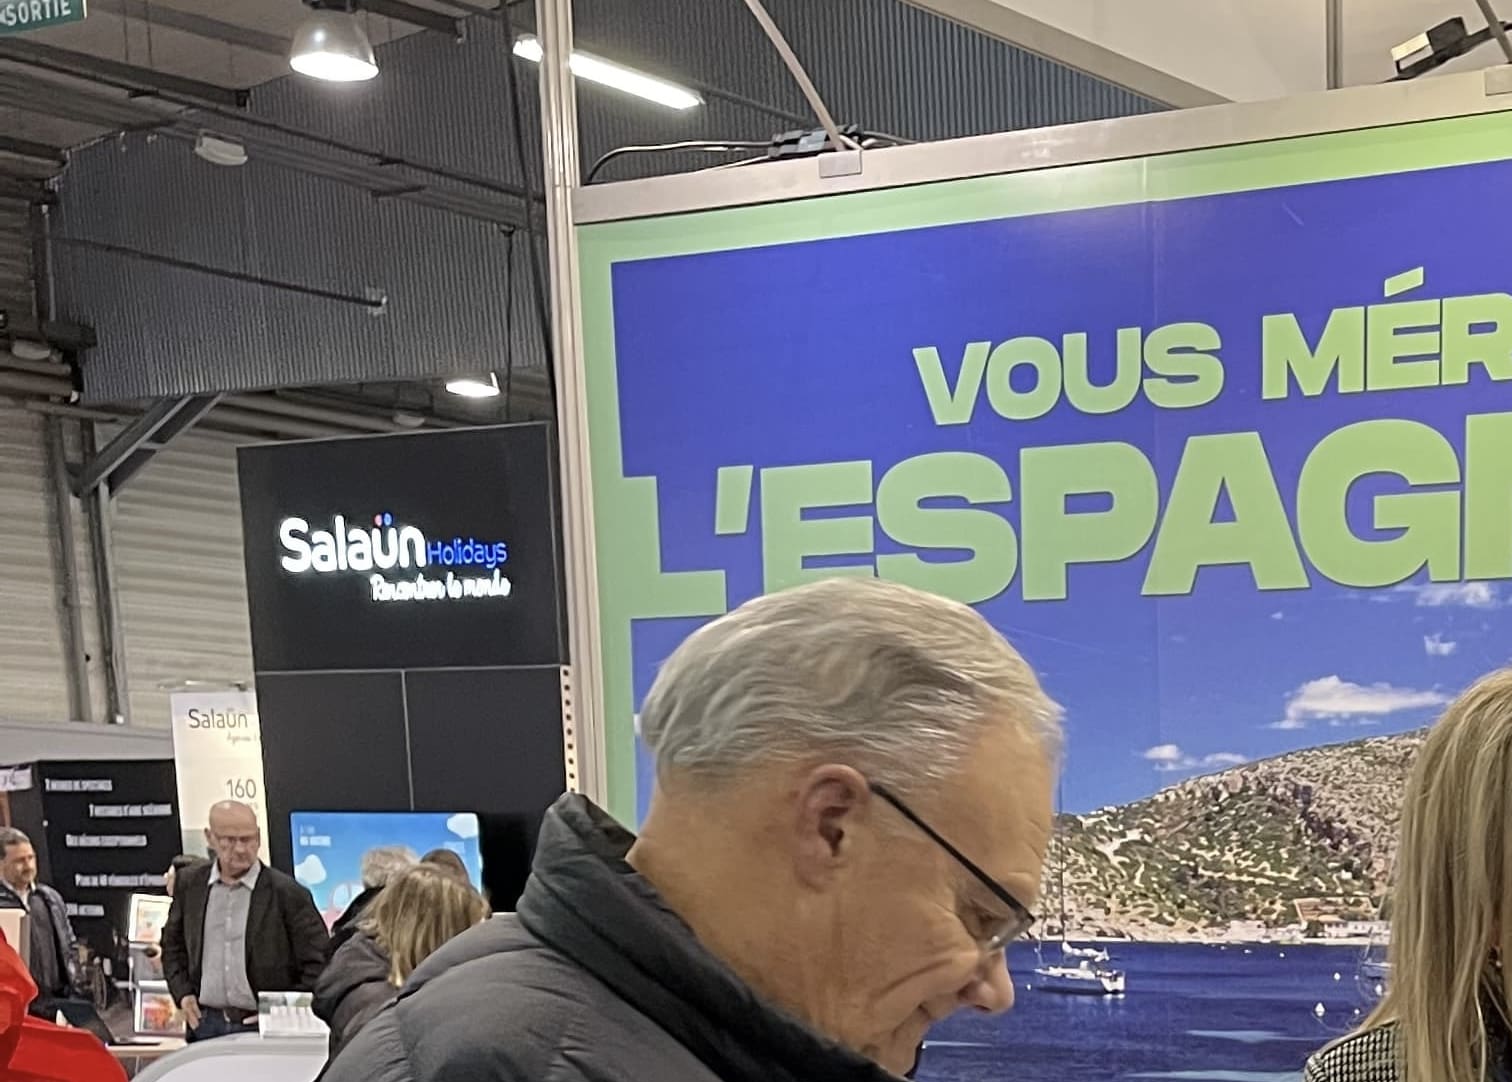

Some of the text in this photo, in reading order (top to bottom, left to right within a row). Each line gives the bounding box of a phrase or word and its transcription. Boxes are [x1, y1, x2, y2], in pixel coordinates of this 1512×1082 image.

[6, 0, 72, 26] SORTIE
[912, 321, 1224, 427] VOUS
[279, 513, 507, 573] Salaün Holidays
[188, 707, 248, 729] Salaün
[226, 778, 257, 799] 160
